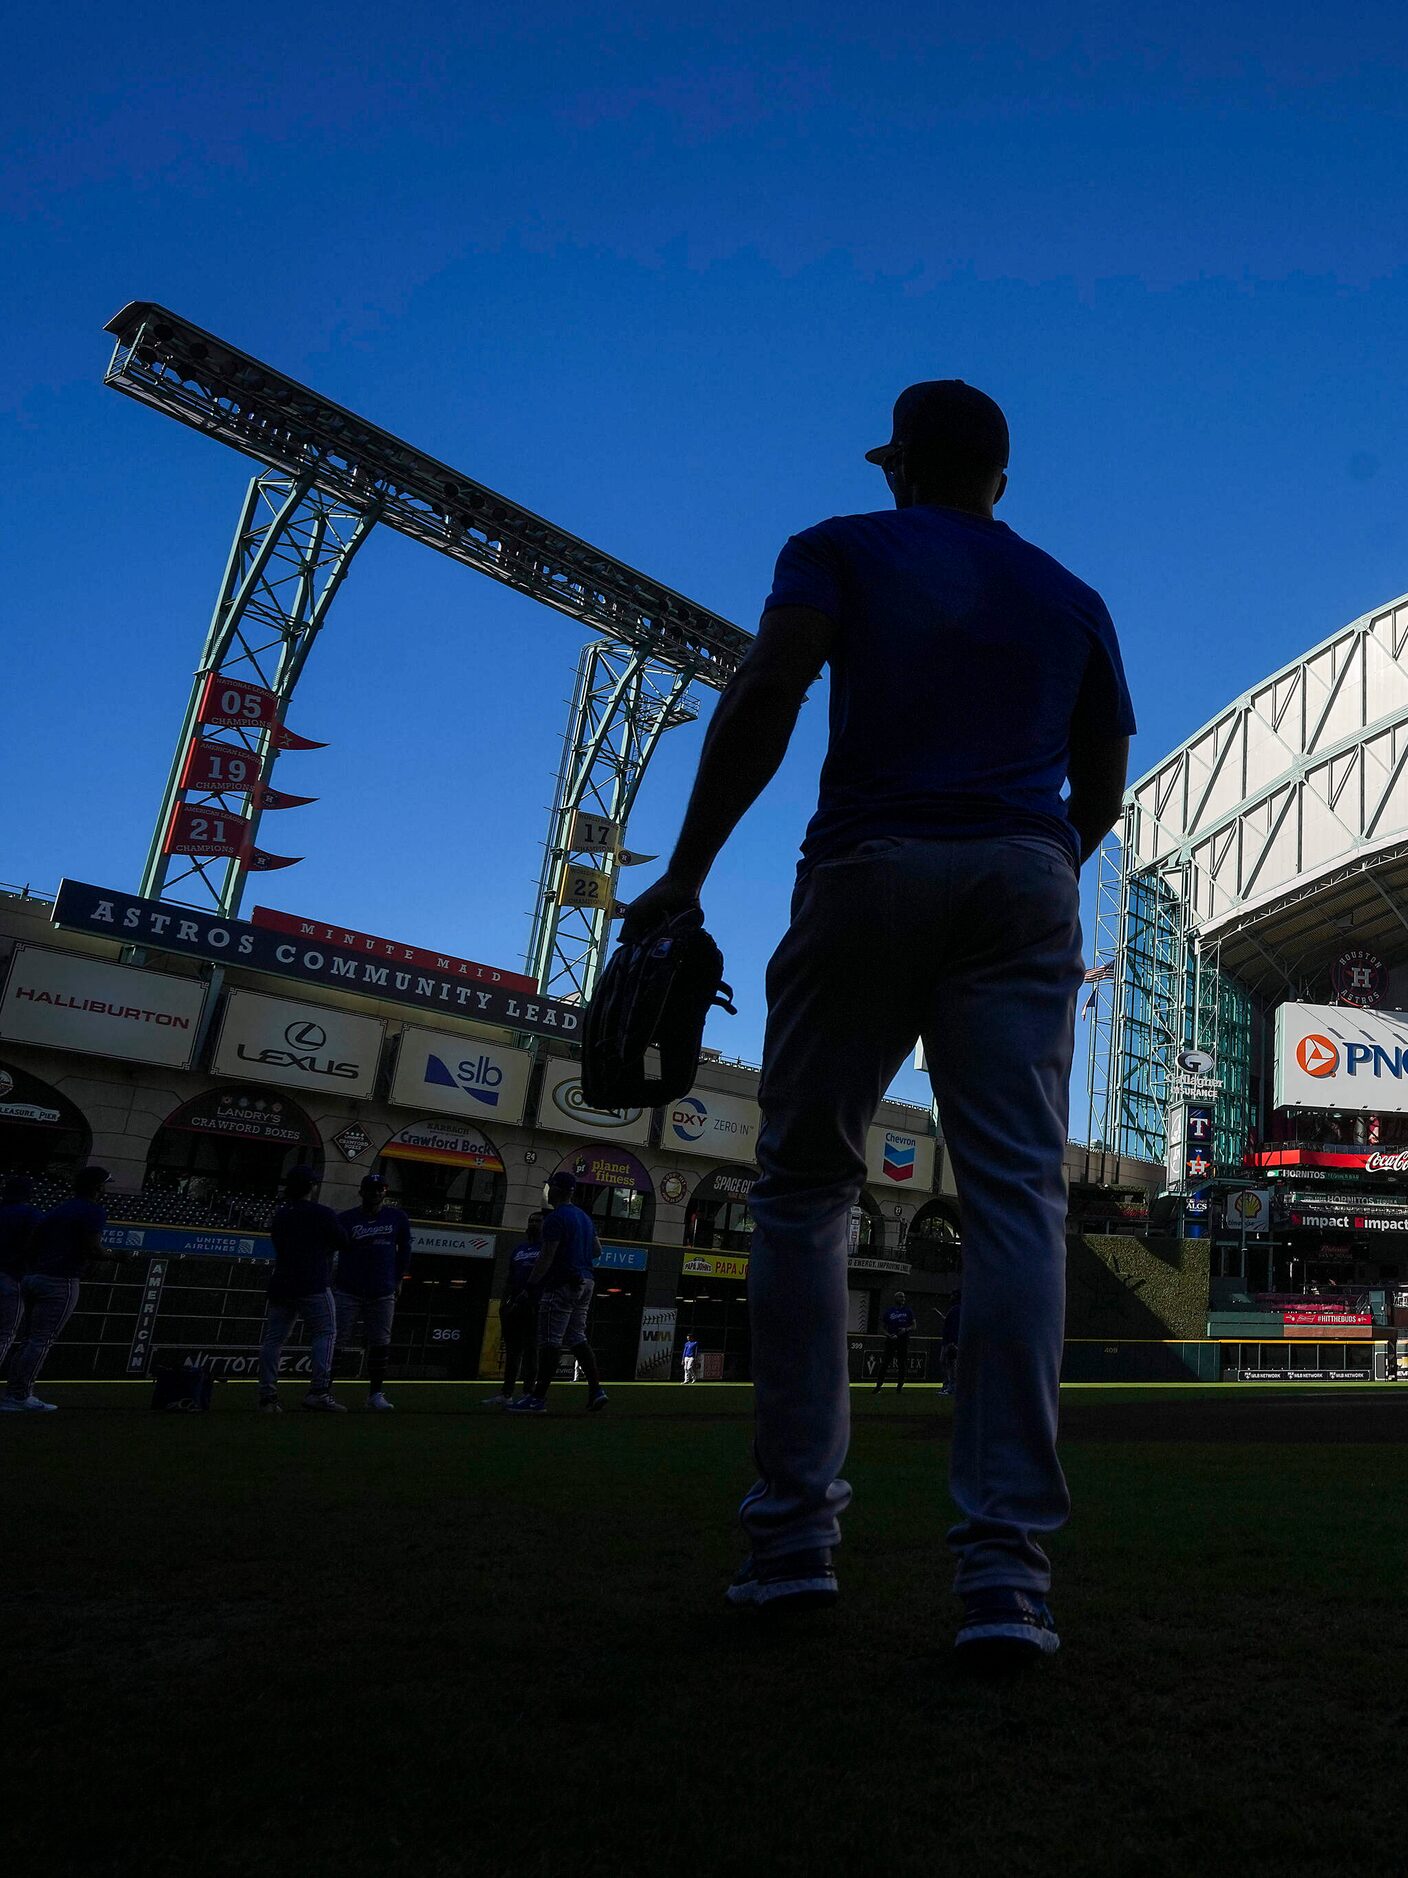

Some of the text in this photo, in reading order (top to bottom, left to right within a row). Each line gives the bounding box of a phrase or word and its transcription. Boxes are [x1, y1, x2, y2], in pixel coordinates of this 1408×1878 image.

[221, 690, 262, 719] 05
[211, 716, 272, 729] CHAMPIONS
[207, 756, 247, 783] 19
[195, 781, 255, 792] CHAMPIONS
[190, 818, 226, 844] 21
[584, 823, 610, 845] 17
[176, 844, 234, 854] CHAMPIONS
[574, 879, 599, 899] 22
[90, 900, 254, 954] ASTROS
[275, 944, 493, 1010] COMMUNITY
[300, 922, 502, 983] MINUTE MAID
[1339, 949, 1383, 970] HOUSTON
[1339, 989, 1382, 1005] ASTROS
[17, 986, 190, 1030] HALLIBURTON
[238, 1043, 360, 1080] LEXUS
[457, 1056, 503, 1087] slb
[1165, 1073, 1224, 1089] Gallagher
[217, 1105, 282, 1124] LANDRY'S
[672, 1111, 707, 1128] OXY
[191, 1116, 301, 1141] CRAWFORD BOXES
[714, 1119, 738, 1133] ZERO
[400, 1131, 496, 1156] Crawford Bock
[885, 1132, 916, 1147] Chevron
[525, 1152, 536, 1163] 24
[591, 1160, 631, 1174] planet
[1282, 1168, 1326, 1180] HORNITOS
[595, 1170, 636, 1187] fitness
[713, 1175, 740, 1193] SPACE
[1186, 1202, 1208, 1210] ALCS
[1327, 1194, 1374, 1205] HORNITOS
[1302, 1215, 1350, 1228] impact
[184, 1242, 235, 1251] AIRLINES
[196, 1236, 237, 1246] UNITED
[417, 1237, 466, 1250] AMERICA
[605, 1252, 636, 1264] FIVE
[715, 1261, 737, 1275] PAPA
[130, 1264, 163, 1368] AMERICAN
